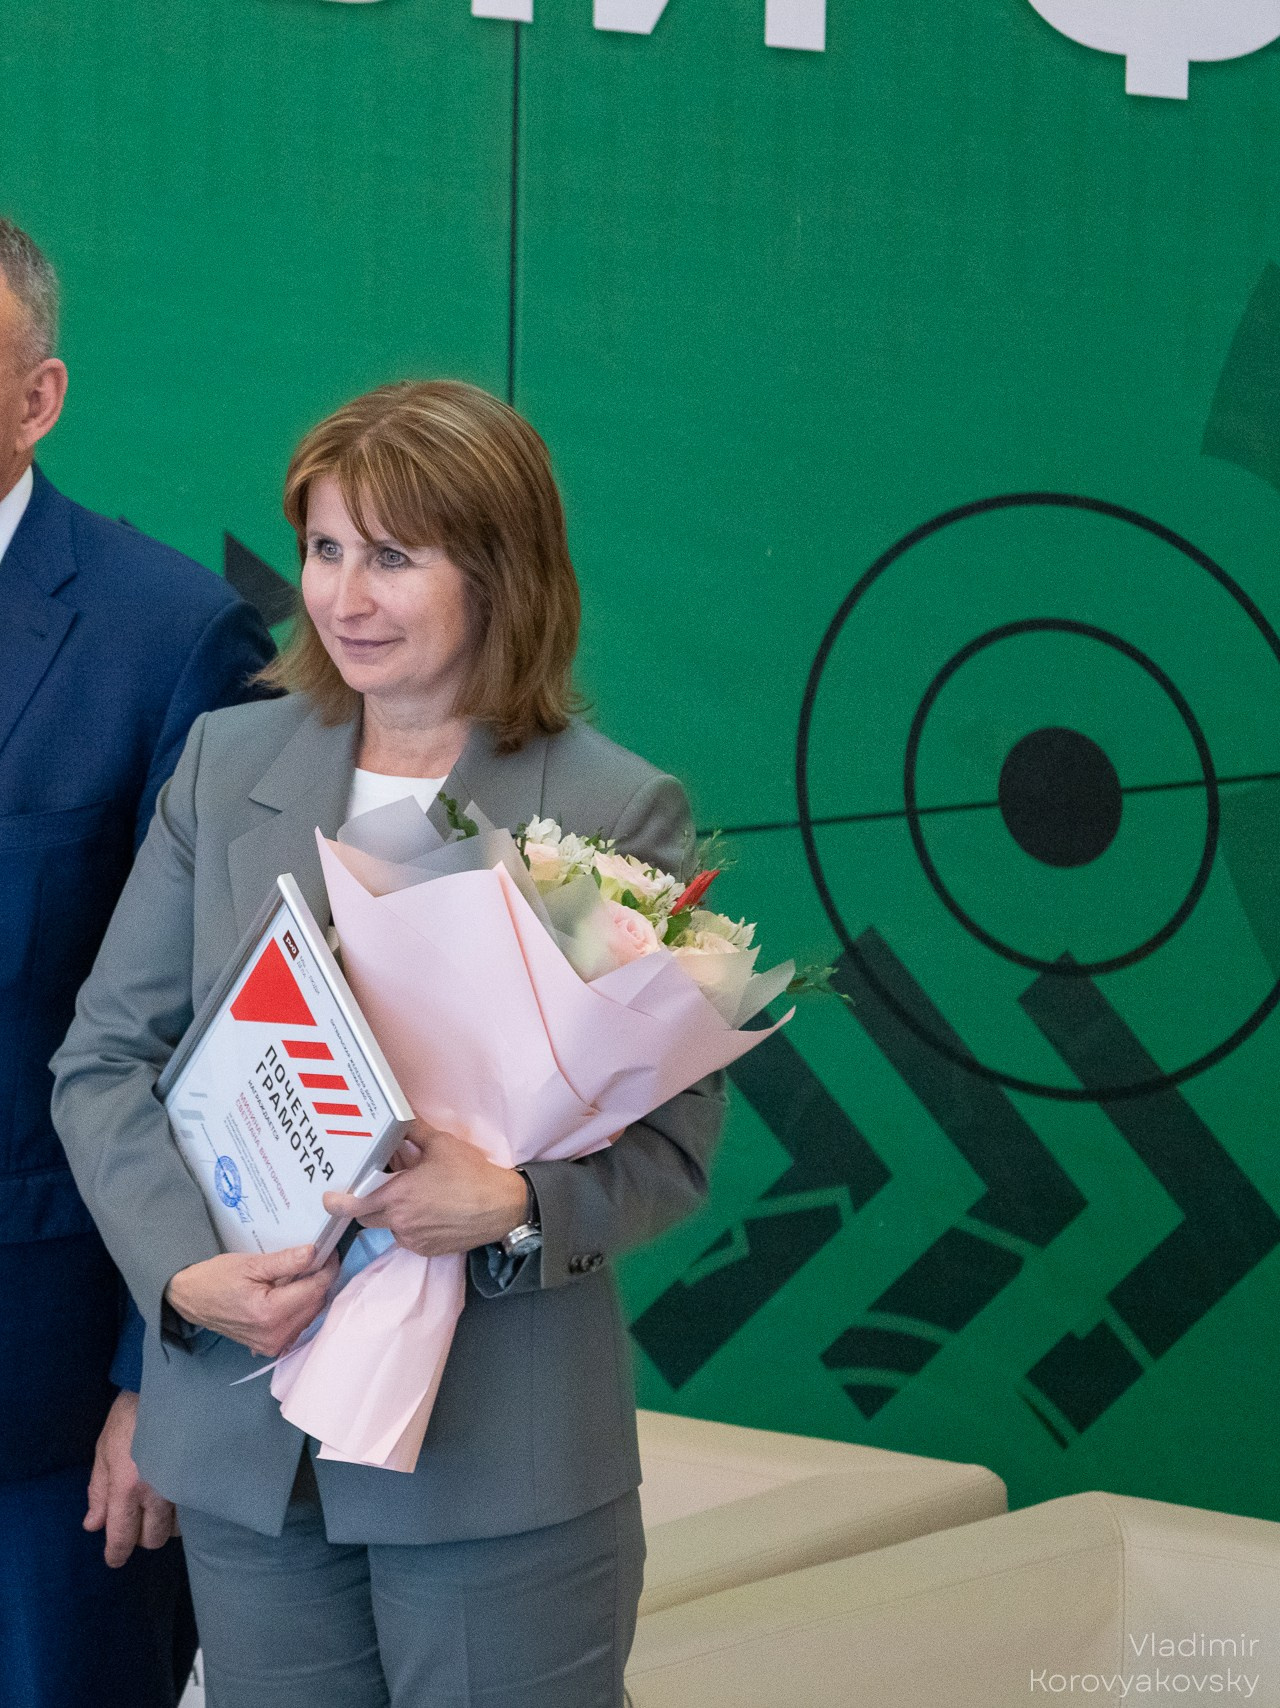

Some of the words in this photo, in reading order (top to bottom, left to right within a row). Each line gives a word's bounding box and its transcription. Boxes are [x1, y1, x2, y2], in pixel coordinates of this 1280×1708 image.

[234, 1097, 261, 1148] СВЕТЛАНА
[258, 1145, 291, 1210] ВИКТОРОВНА
[247, 1078, 280, 1142] НАГРАЖДАЕТСЯ
[254, 1059, 318, 1184] ГРАМОТА
[264, 1043, 335, 1182] ПОЧЕТНАЯ
